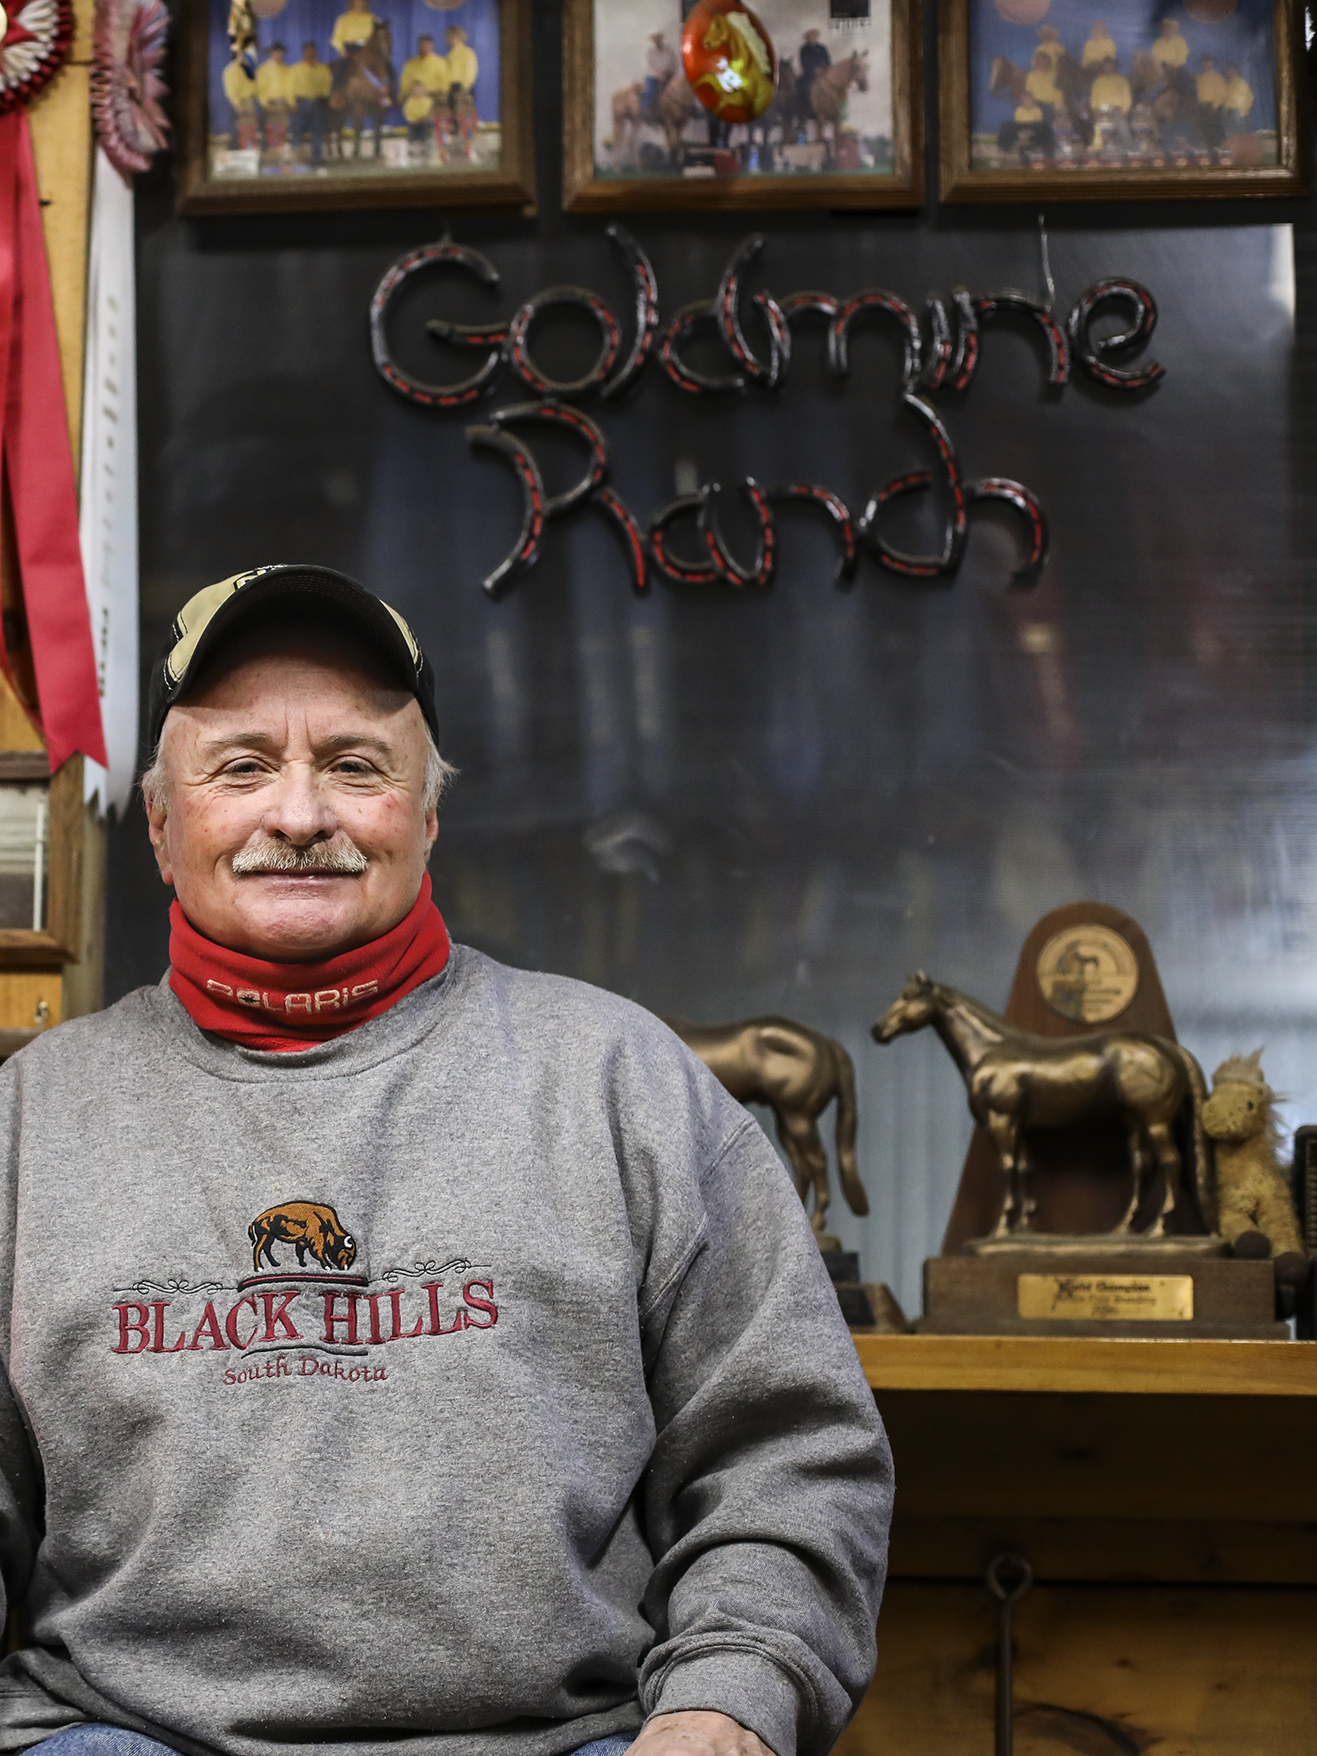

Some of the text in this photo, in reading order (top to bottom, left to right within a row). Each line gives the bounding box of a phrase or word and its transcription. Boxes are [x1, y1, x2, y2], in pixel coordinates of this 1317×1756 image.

[370, 225, 1165, 405] Goldmine
[465, 393, 1049, 595] Ranch
[206, 979, 378, 1014] POLARIS
[112, 1280, 499, 1354] BLACK HILLS
[223, 1357, 389, 1386] South Dakota
